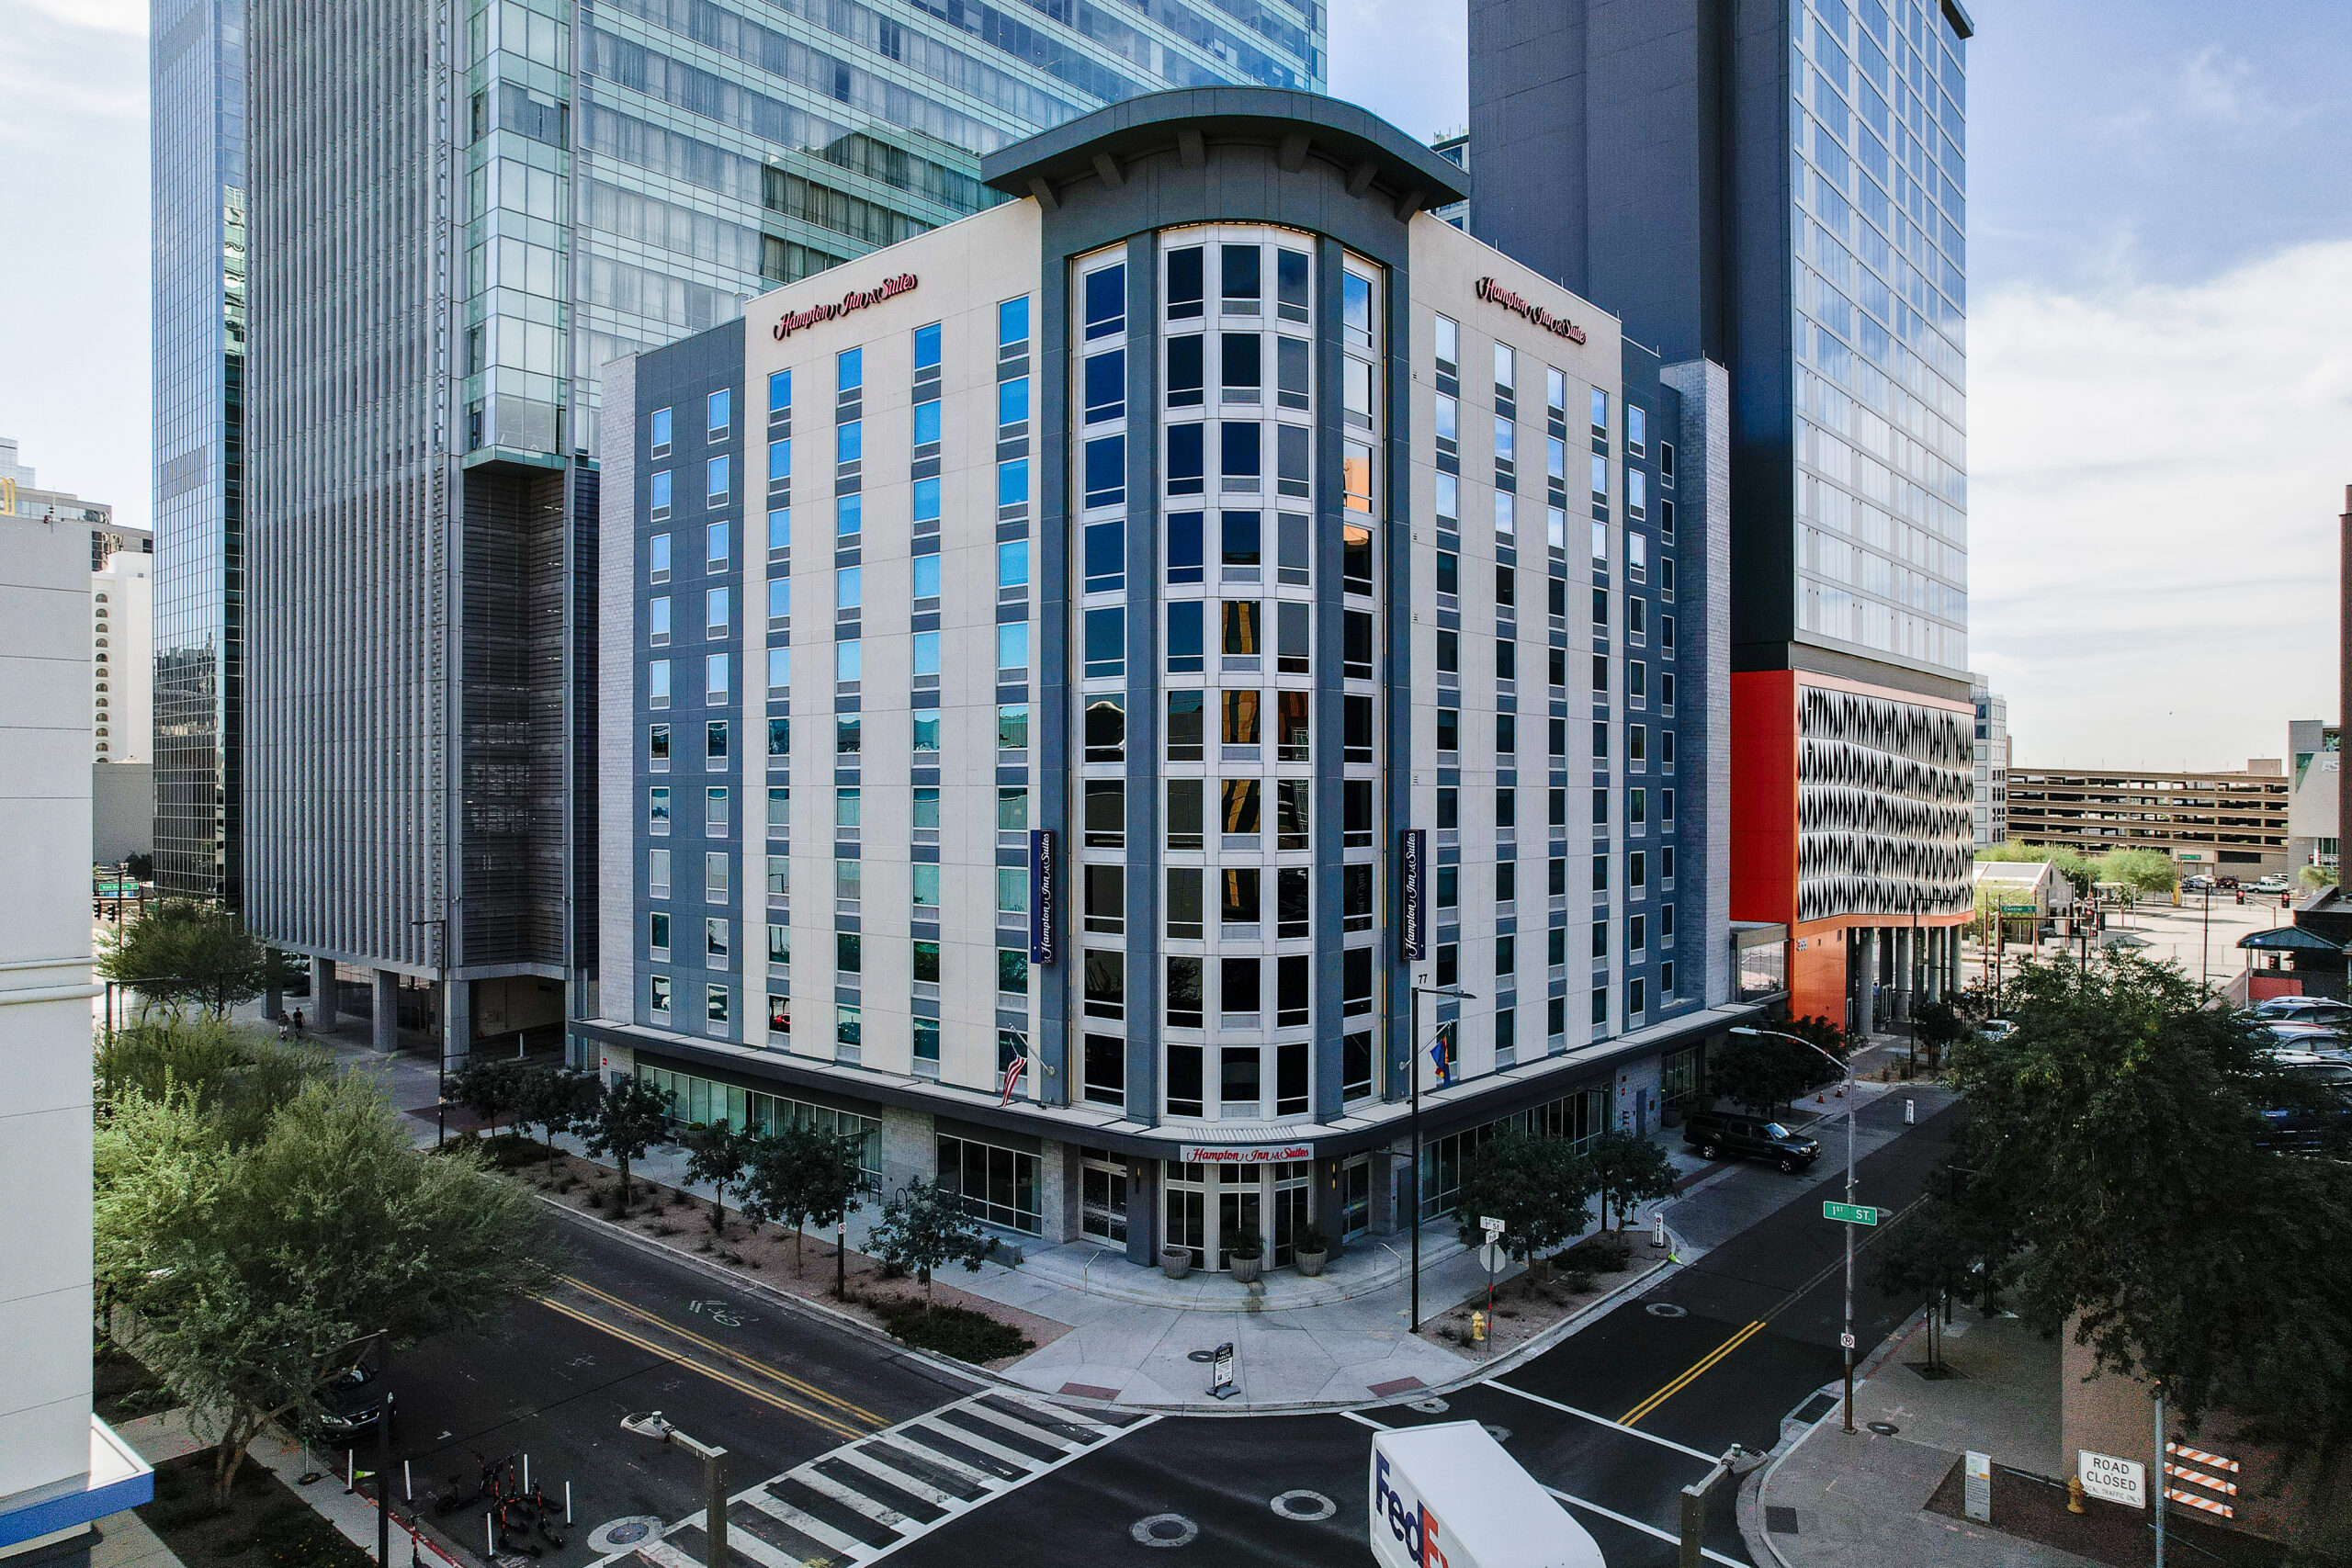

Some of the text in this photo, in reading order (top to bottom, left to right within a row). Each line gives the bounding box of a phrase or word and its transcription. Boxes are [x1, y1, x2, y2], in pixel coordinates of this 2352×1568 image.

[774, 304, 836, 341] Hampton
[837, 291, 871, 317] Inn
[877, 274, 918, 299] Suites
[1476, 276, 1532, 318] Hampton
[1531, 307, 1557, 333] Inn
[1562, 319, 1587, 345] Suites
[1040, 833, 1050, 865] Suites
[1406, 832, 1416, 864] Suites
[1041, 870, 1051, 900] Inn
[1407, 870, 1417, 899] Inn
[1042, 901, 1052, 960] Hampton
[1405, 899, 1418, 957] Hampton
[1186, 1148, 1244, 1163] Hampton
[1246, 1150, 1274, 1162] Inn
[1280, 1147, 1309, 1158] Suites
[2086, 1471, 2136, 1491] CLOSED
[2093, 1457, 2130, 1474] ROAD
